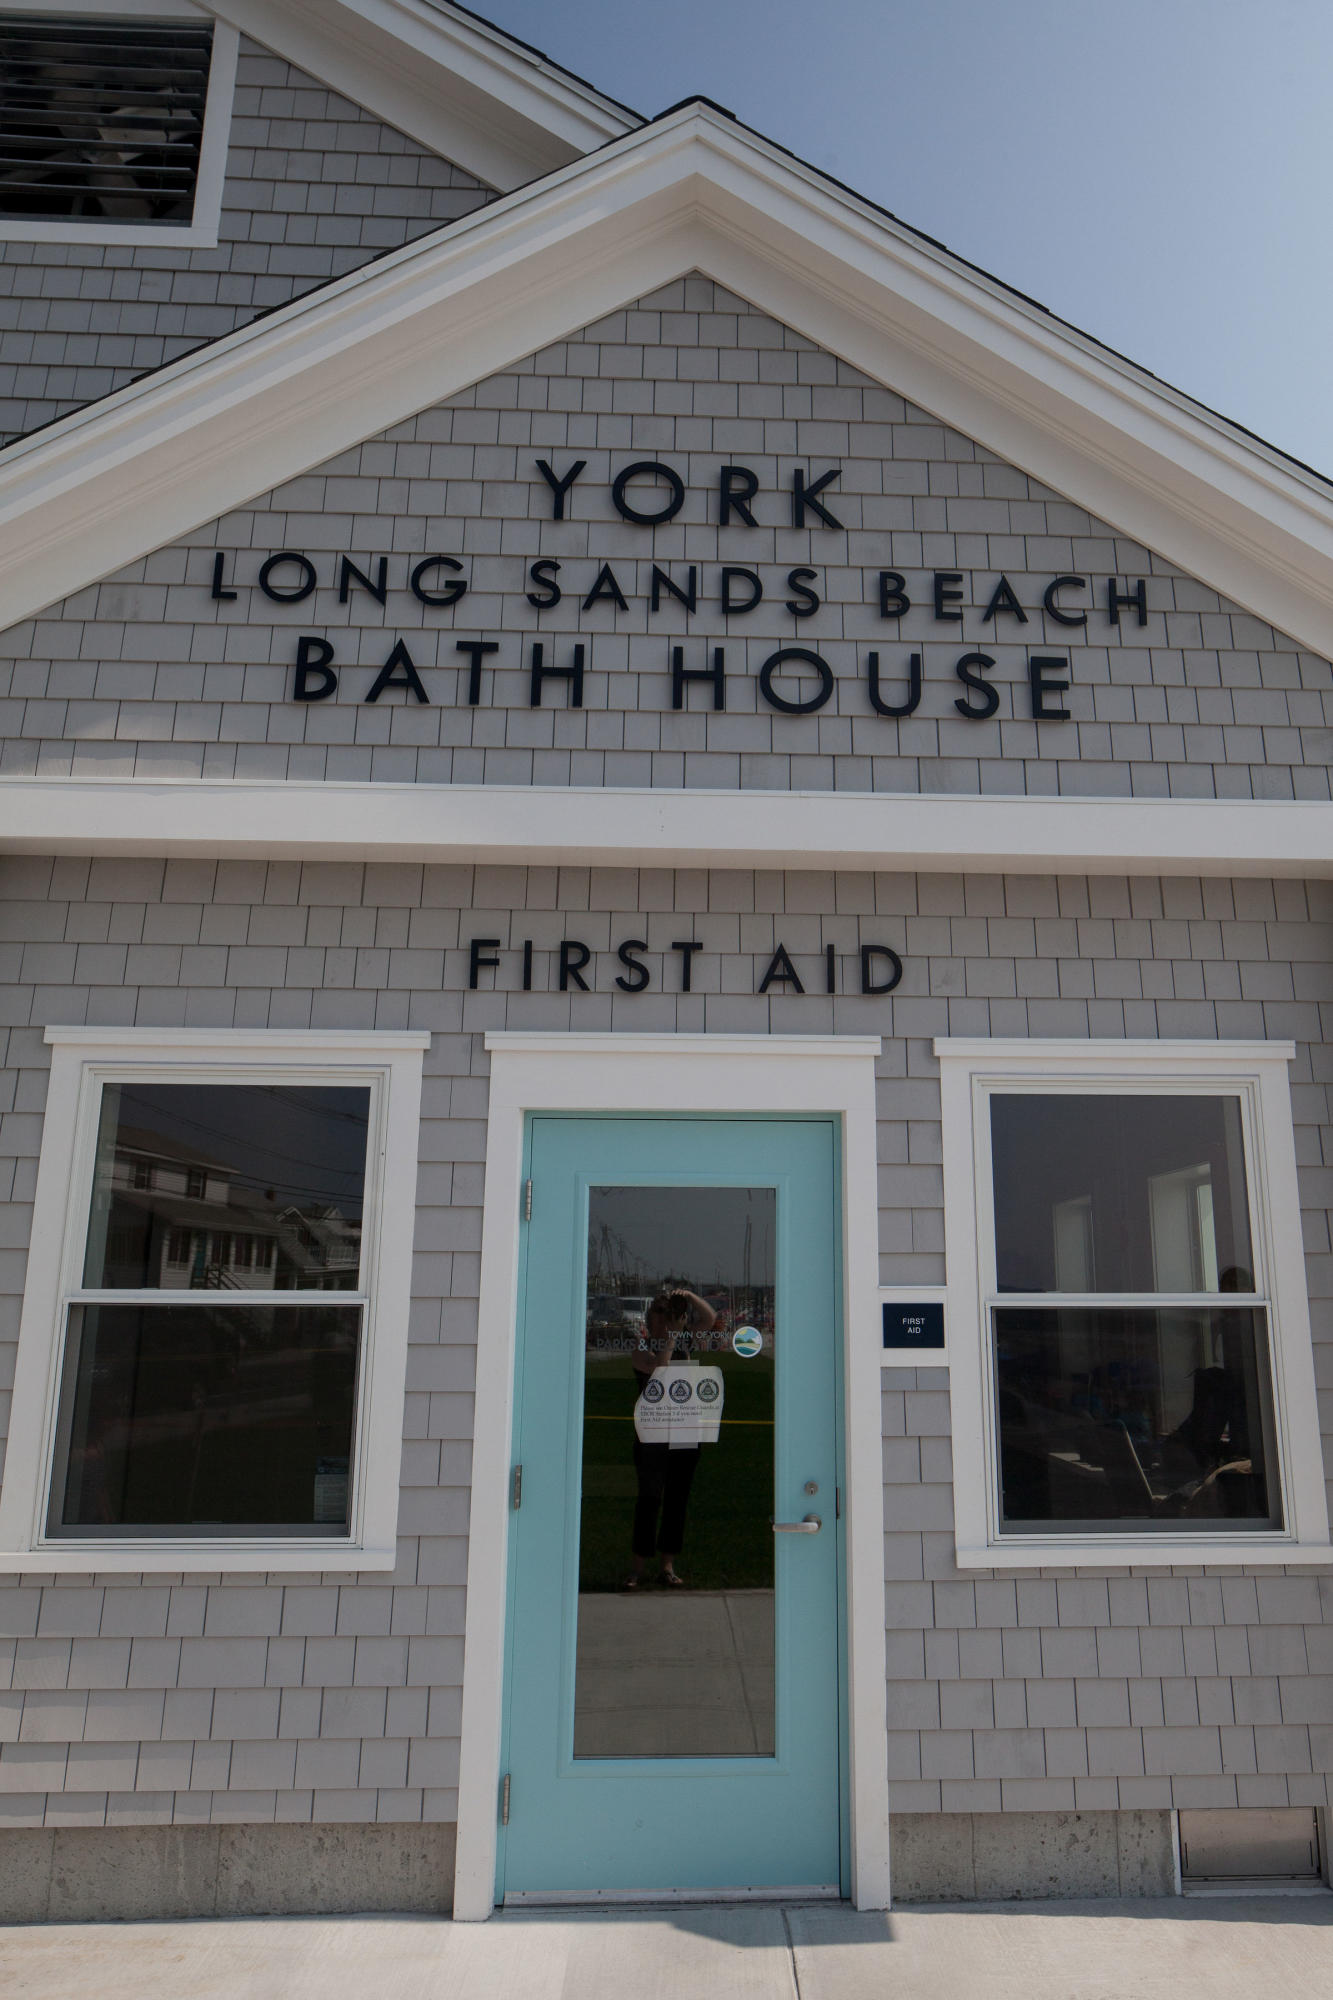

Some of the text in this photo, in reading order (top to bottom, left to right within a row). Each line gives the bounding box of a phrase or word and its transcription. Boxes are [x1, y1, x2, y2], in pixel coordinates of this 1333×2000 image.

[535, 459, 845, 530] YORK
[211, 551, 1149, 627] LONG SANDS BEACH
[293, 636, 1072, 721] BATH HOUSE
[469, 938, 904, 995] FIRST AID
[668, 1331, 730, 1339] TOWN OF YORK
[902, 1317, 926, 1325] FIRST
[907, 1326, 921, 1334] AID
[596, 1338, 732, 1352] PARKS & REREATIO
